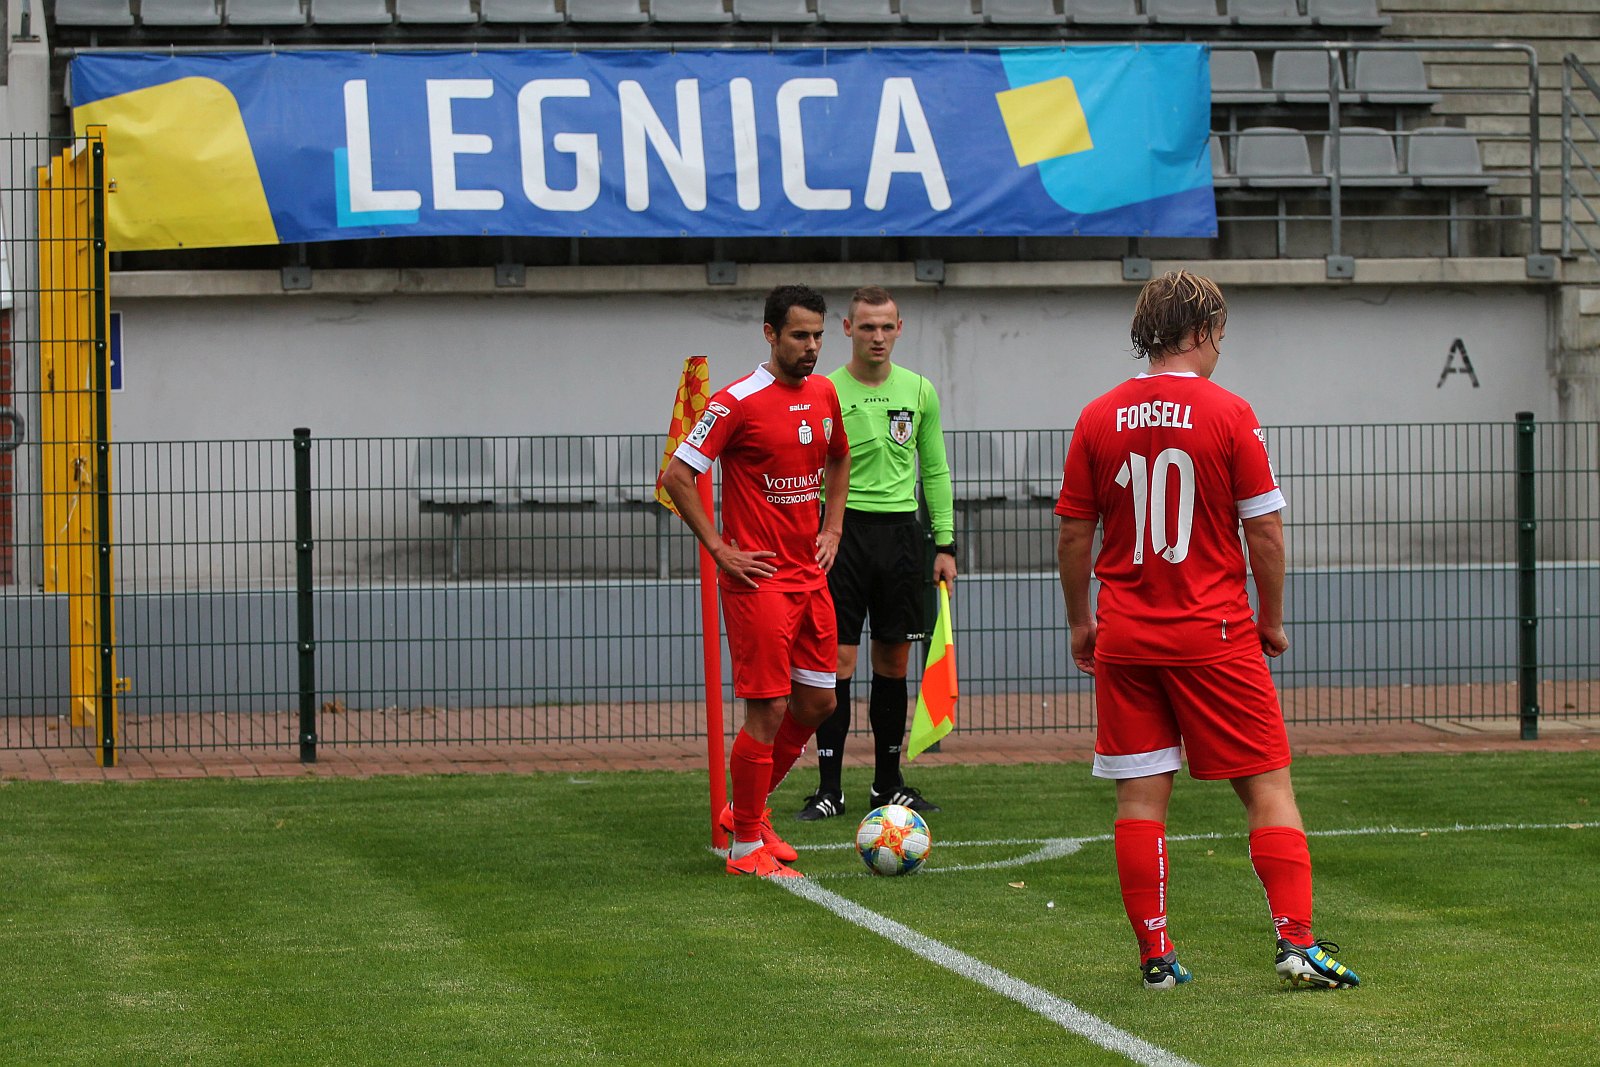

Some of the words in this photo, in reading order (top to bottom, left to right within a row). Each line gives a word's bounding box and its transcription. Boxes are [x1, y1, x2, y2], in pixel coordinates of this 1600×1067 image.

[343, 77, 952, 212] LEGNICA
[1437, 338, 1480, 389] A
[789, 403, 812, 412] saller
[1116, 400, 1193, 432] FORSELL
[1114, 447, 1196, 565] 10
